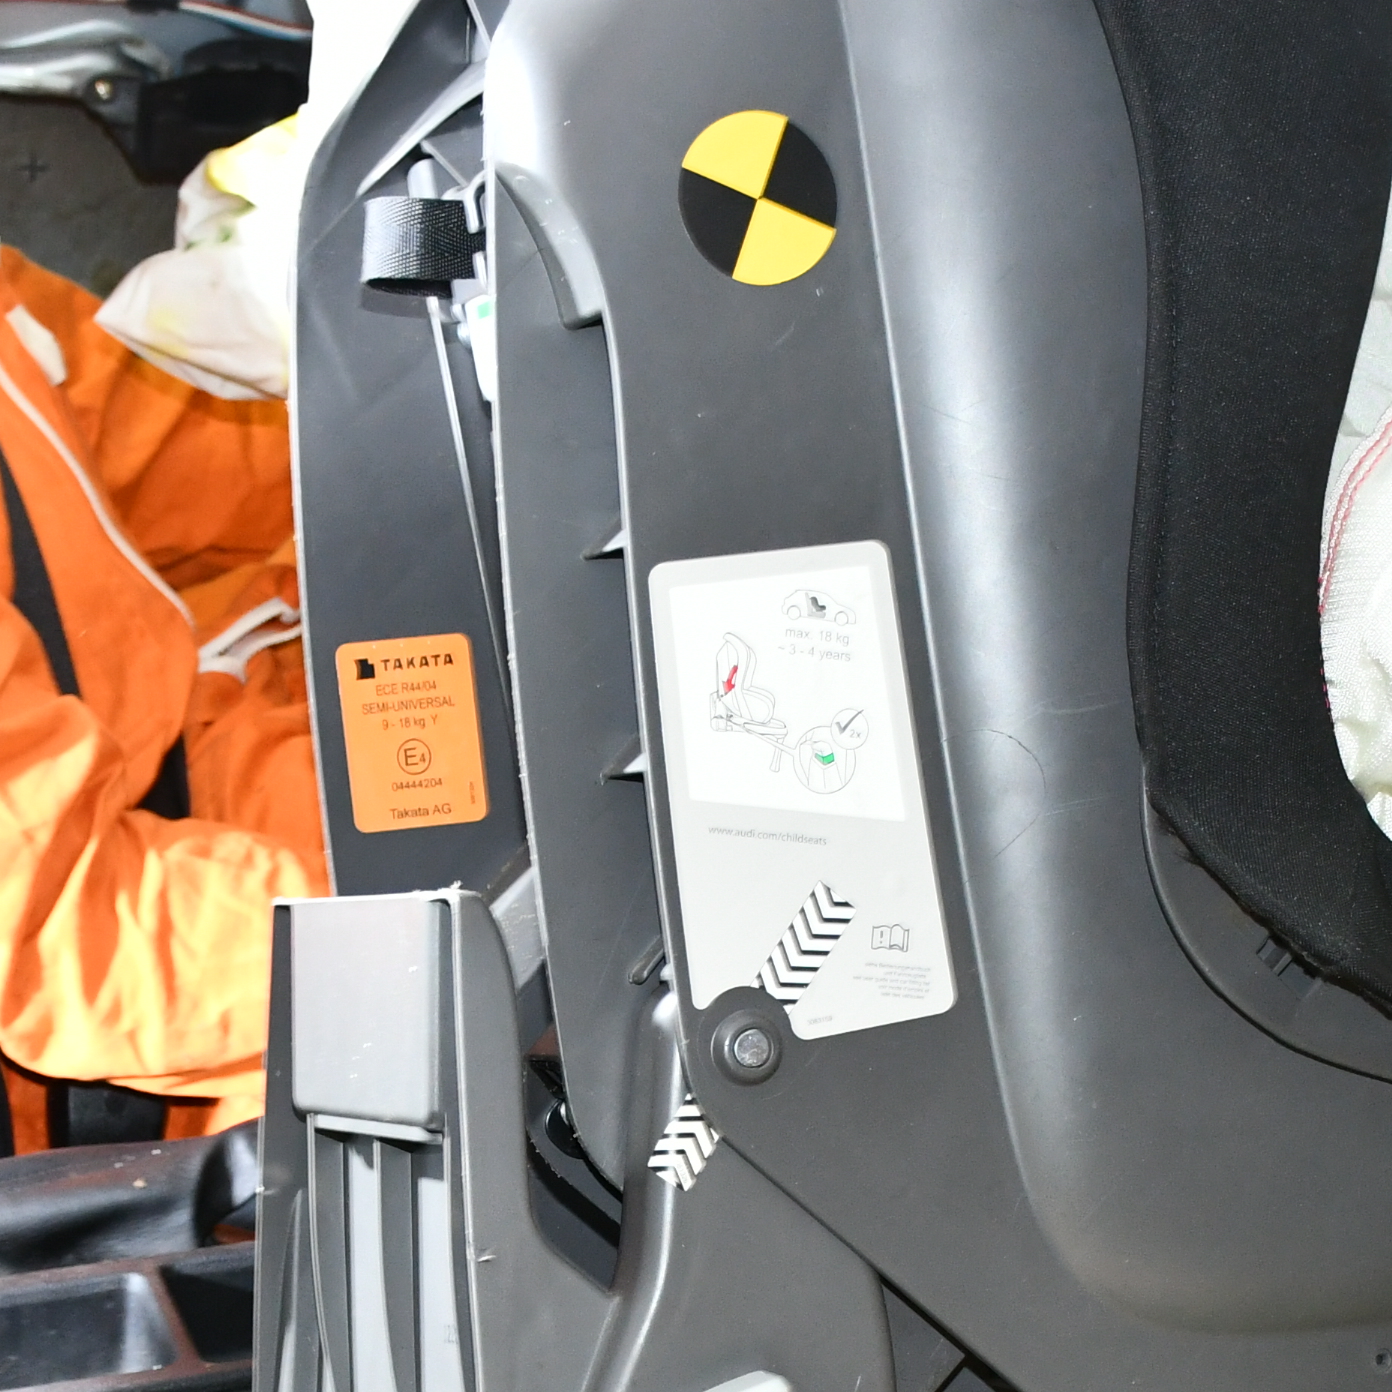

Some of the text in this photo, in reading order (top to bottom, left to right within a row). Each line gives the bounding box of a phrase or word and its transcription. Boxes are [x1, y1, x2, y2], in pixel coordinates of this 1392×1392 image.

[785, 628, 850, 647] max. 18 kg
[789, 643, 796, 655] 3
[808, 646, 815, 657] 4
[819, 650, 851, 662] years
[381, 653, 454, 671] TAKATA
[376, 680, 437, 696] ECE R44/04
[361, 695, 455, 715] SEMI-UNIVERSAL
[382, 719, 389, 731] 9
[399, 717, 411, 729] 18
[413, 715, 426, 730] kg
[431, 714, 438, 726] Y
[849, 728, 861, 739] 2x
[391, 778, 443, 792] 04444204
[389, 803, 452, 820] Takata AG
[708, 826, 827, 846] www.audi.com/childseats
